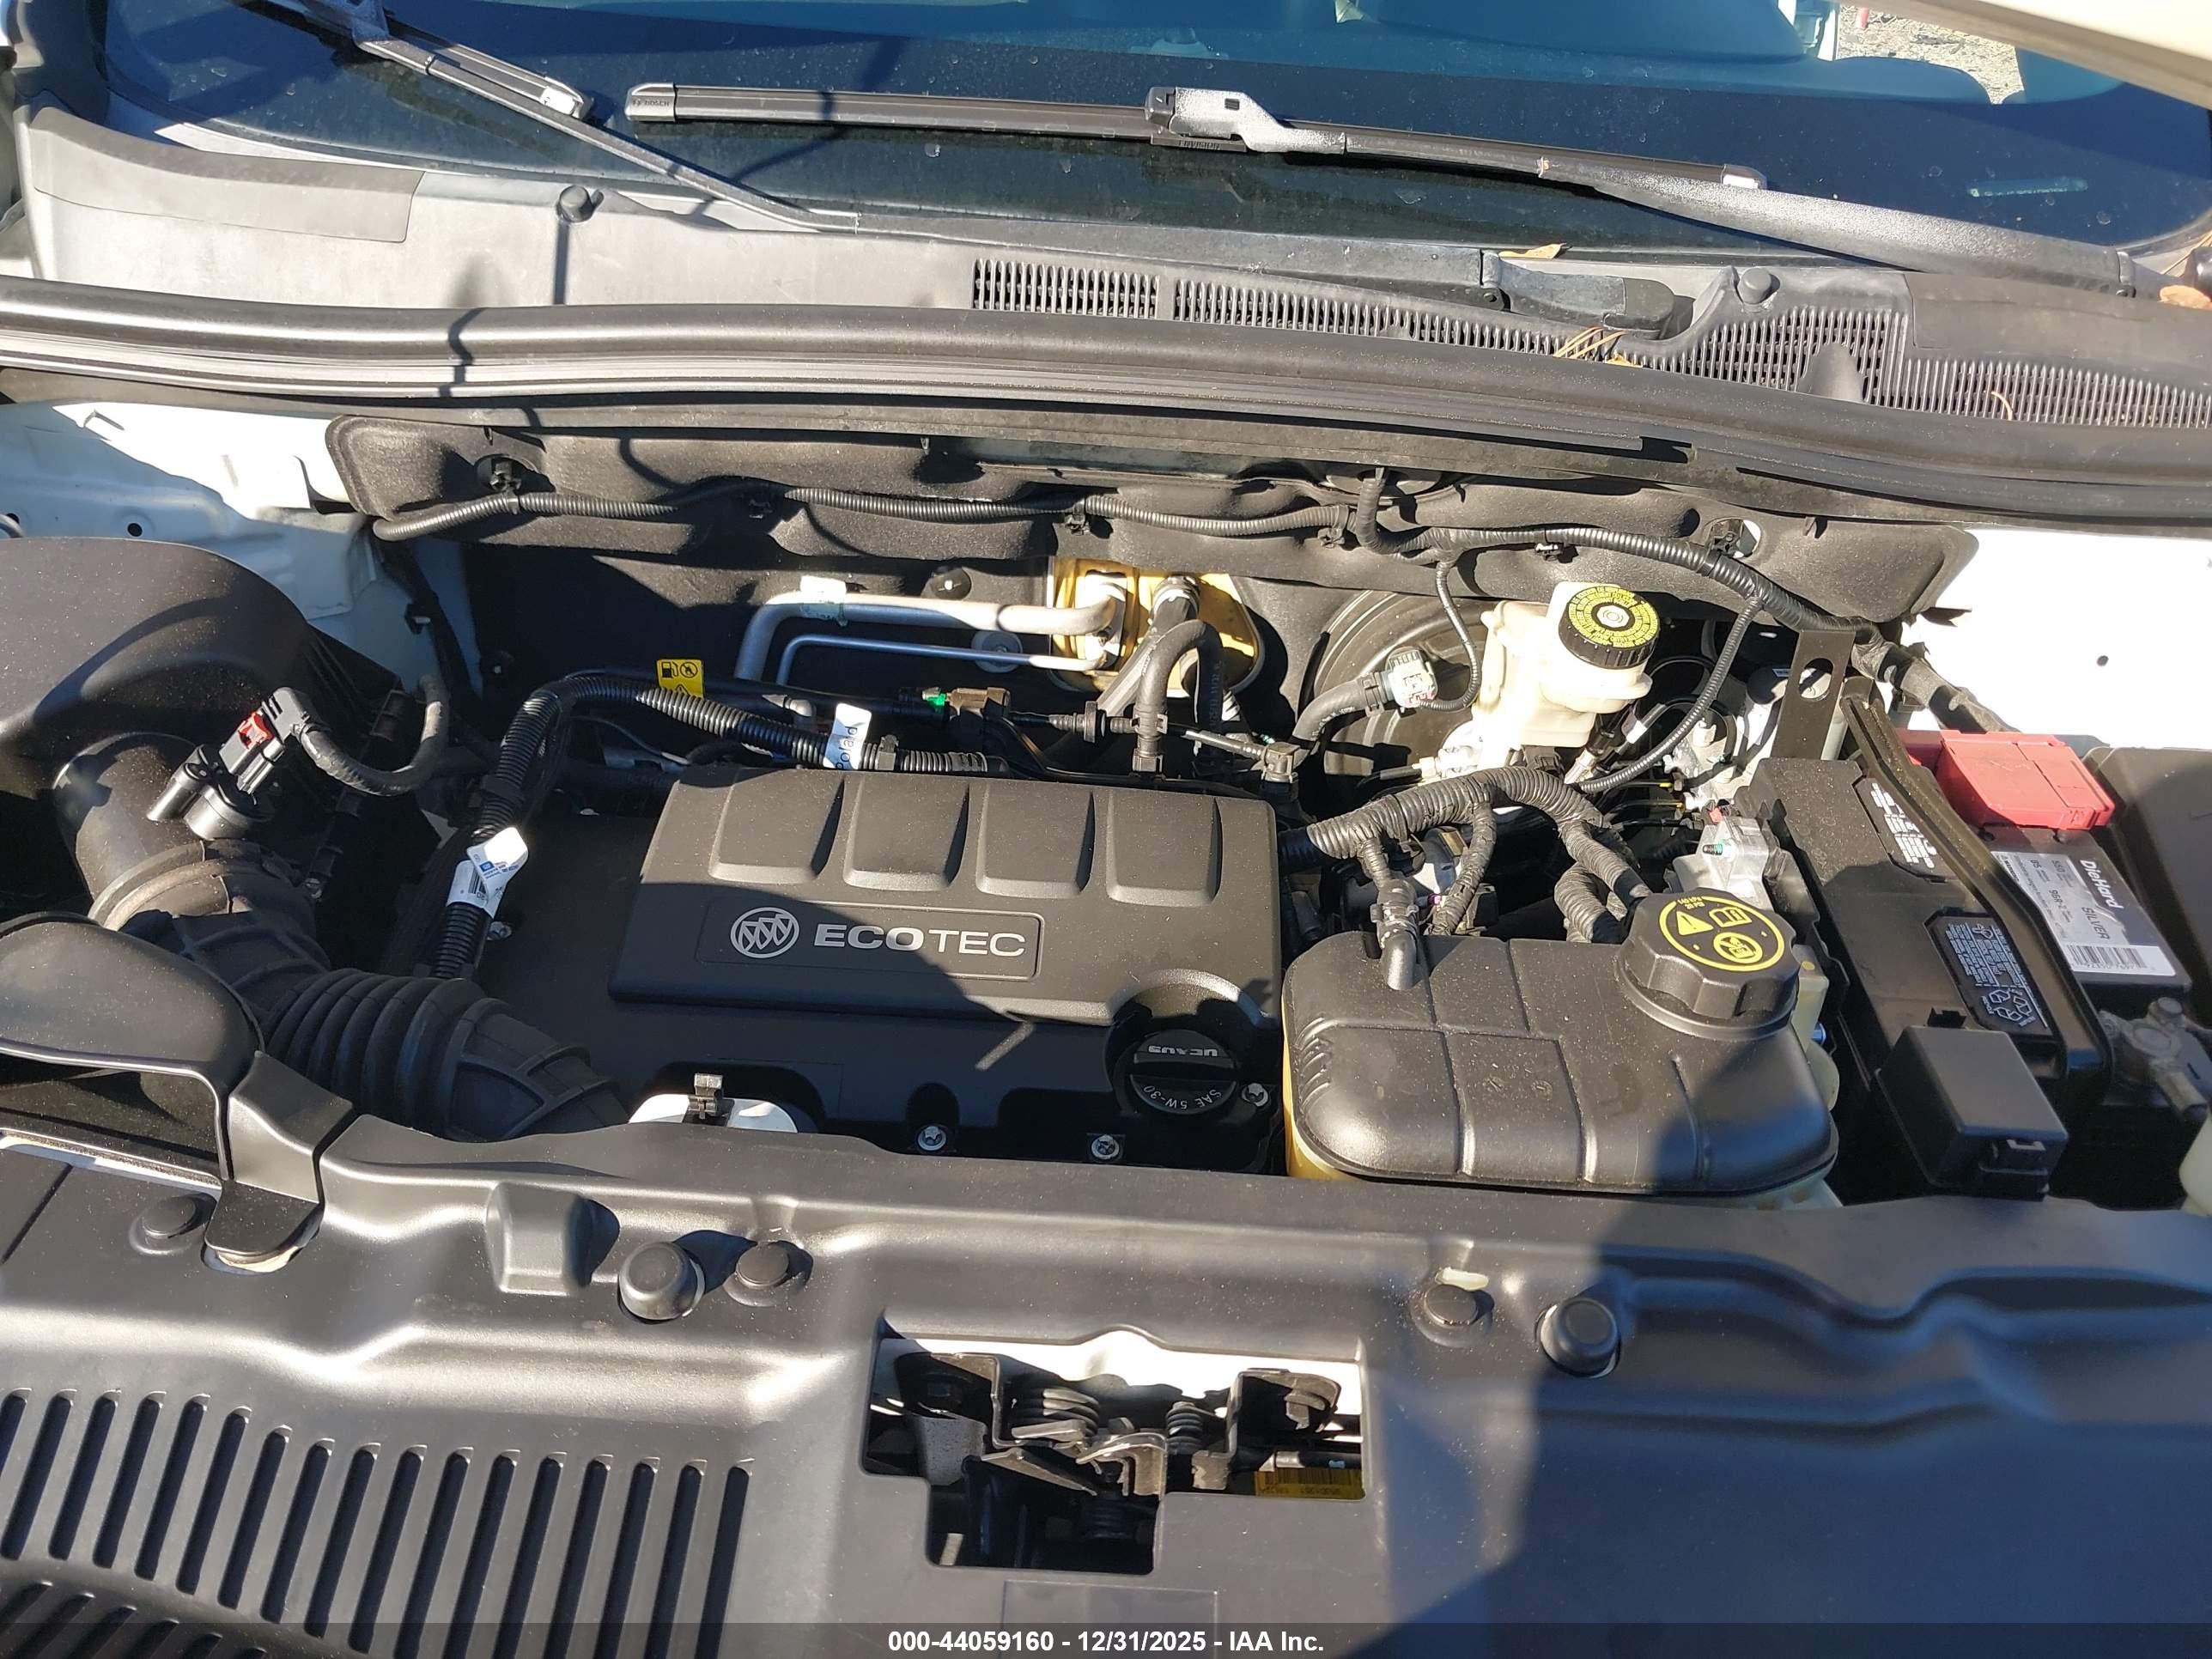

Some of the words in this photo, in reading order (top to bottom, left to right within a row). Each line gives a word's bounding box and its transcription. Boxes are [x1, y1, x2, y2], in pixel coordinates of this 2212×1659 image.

[2080, 859, 2124, 909] DieHard
[813, 923, 1026, 957] ECOTEC
[2081, 907, 2111, 940] SILVER
[1143, 1085, 1188, 1109] 5W-30
[1194, 1089, 1222, 1108] SAE
